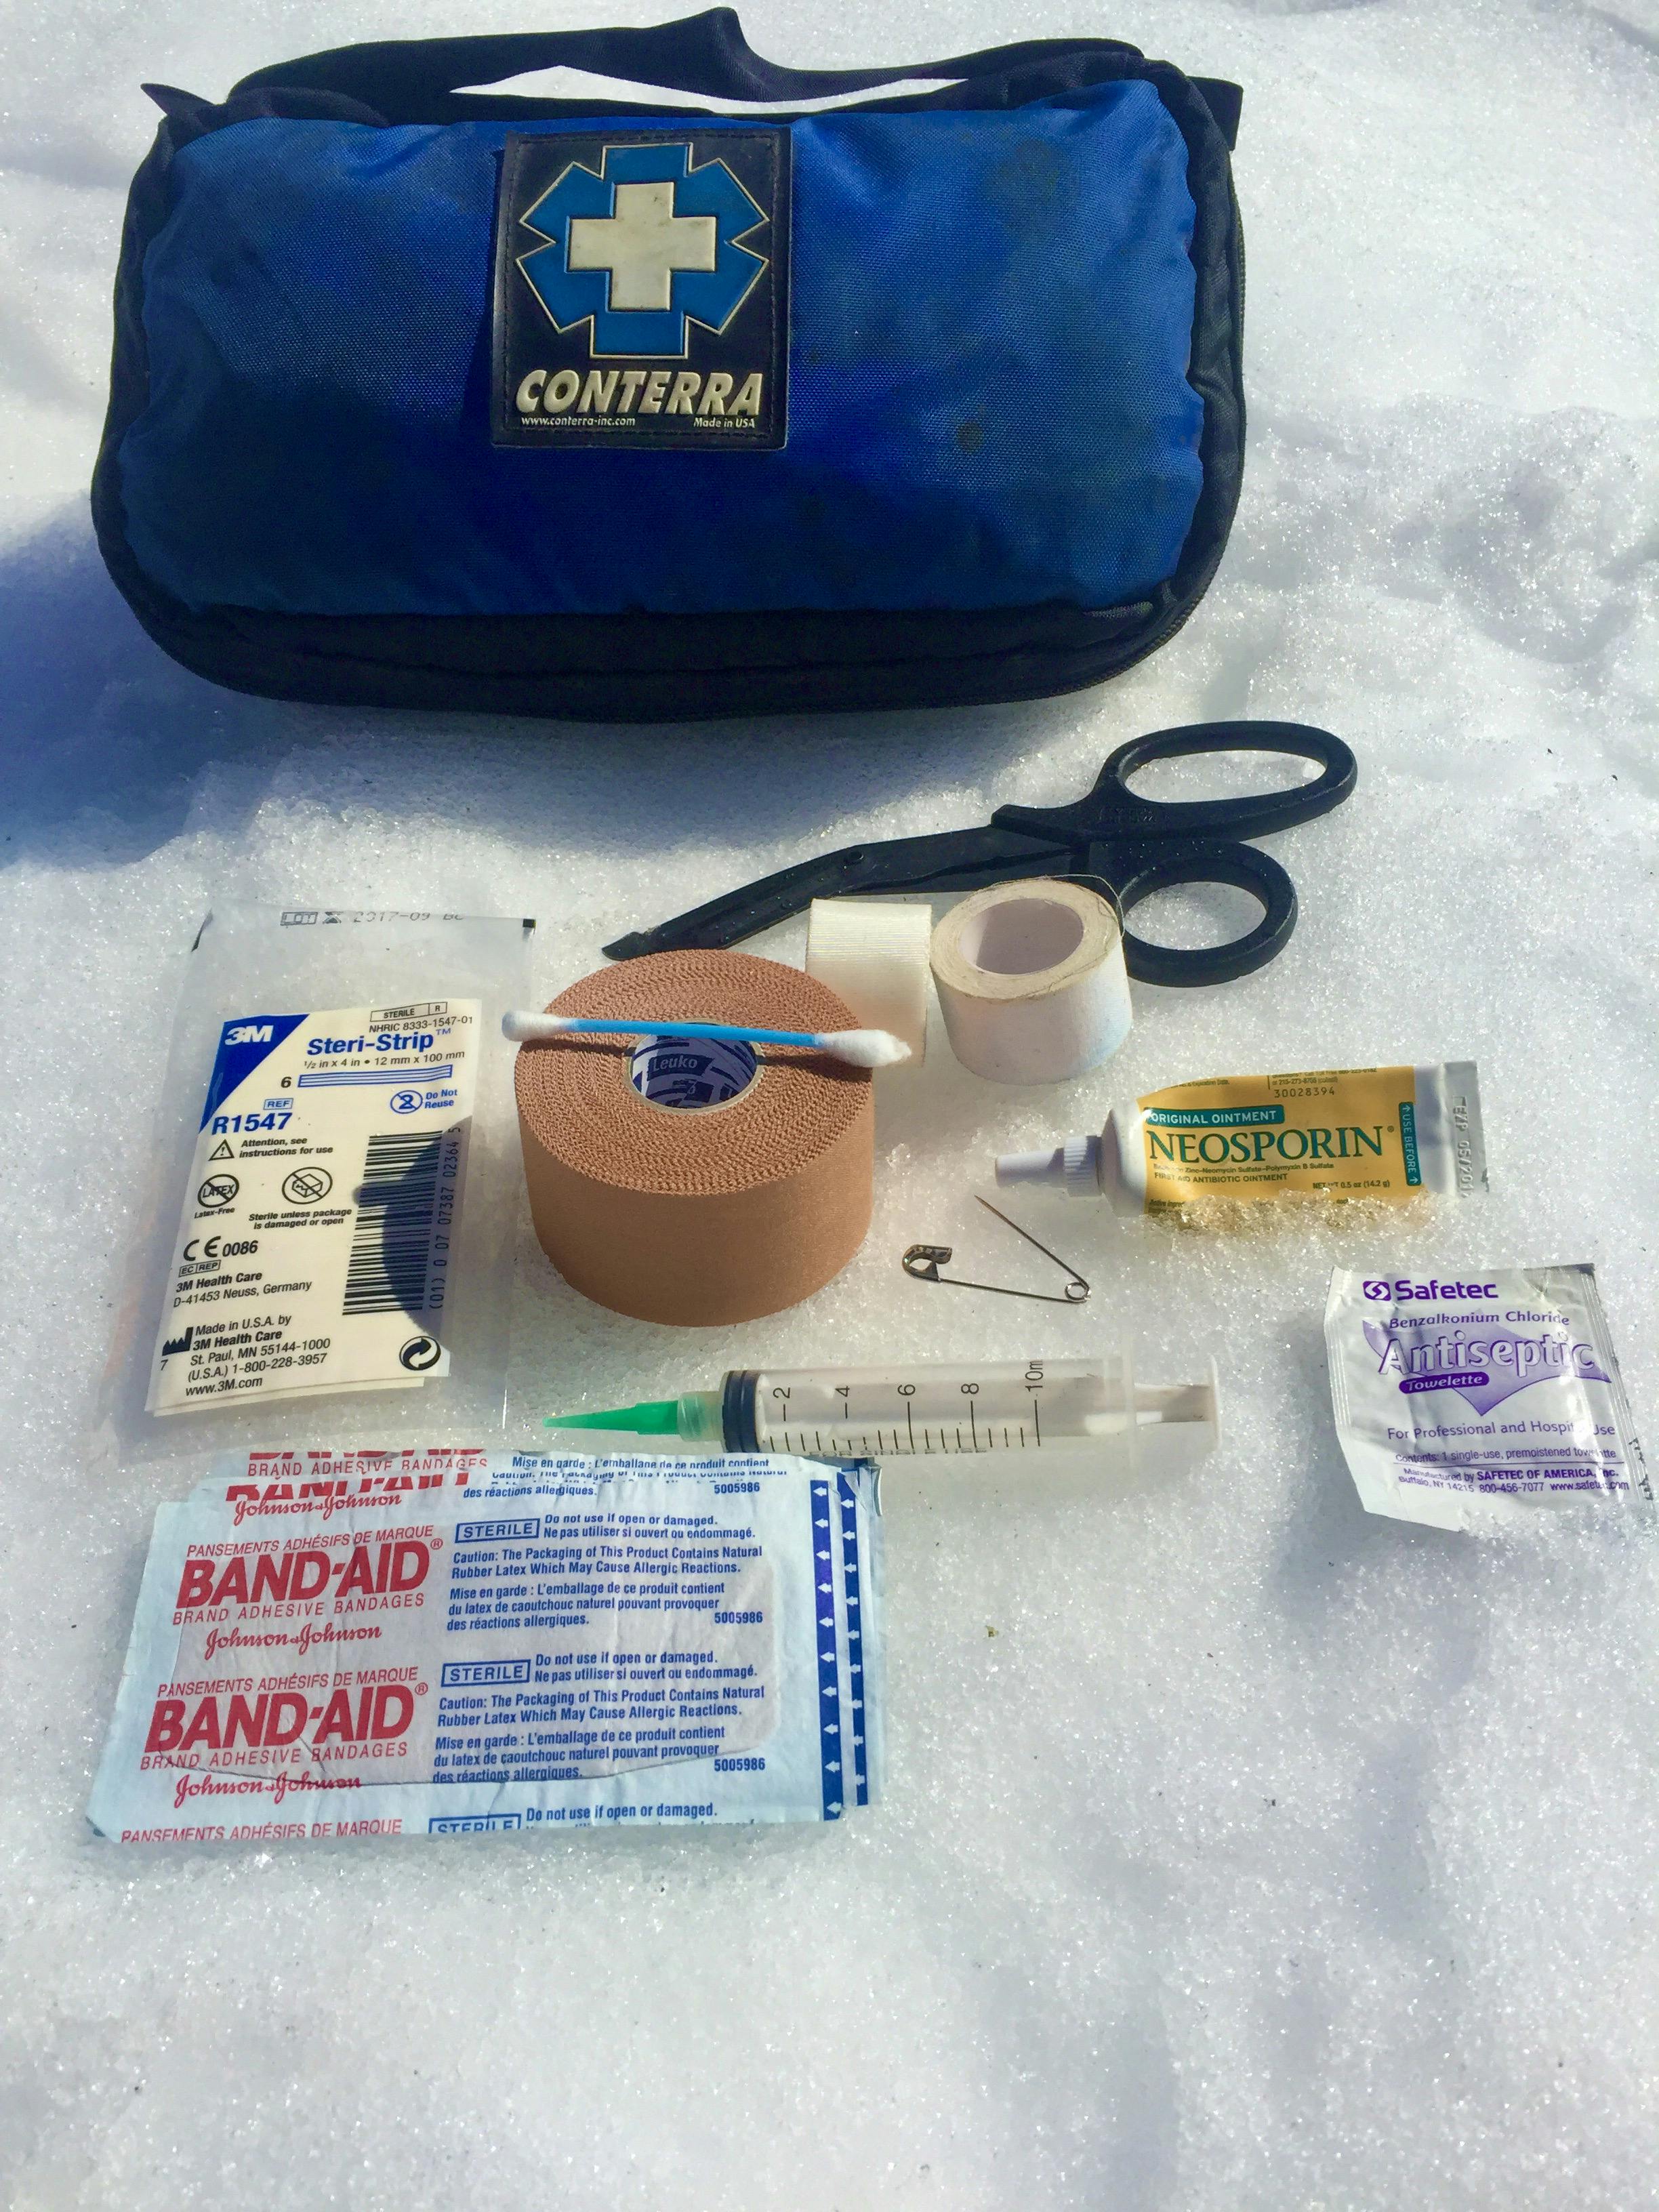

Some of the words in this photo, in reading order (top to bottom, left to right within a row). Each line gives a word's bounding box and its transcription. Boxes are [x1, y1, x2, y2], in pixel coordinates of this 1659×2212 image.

[516, 369, 763, 416] CONTERRA
[522, 416, 636, 426] www.conterra-inc.com
[694, 417, 721, 427] Made
[724, 418, 733, 428] in
[735, 418, 755, 428] USA
[384, 1008, 415, 1019] STERILE
[369, 1023, 400, 1033] NHRIC
[403, 1016, 472, 1031] 8333-1547-01
[224, 1025, 273, 1045] 3M
[307, 1032, 434, 1055] Steri-Strip
[319, 1060, 329, 1068] in
[375, 1057, 388, 1065] 12
[424, 1053, 443, 1063] 100
[445, 1051, 465, 1060] mm
[653, 1054, 698, 1071] Leuko
[281, 1077, 291, 1088] 6
[426, 1092, 438, 1100] Do
[441, 1089, 457, 1097] Not
[1274, 1086, 1334, 1098] 30028394
[425, 1100, 454, 1109] Reuse
[211, 1112, 293, 1135] R1547
[1151, 1113, 1208, 1124] ORIGINAL
[1212, 1111, 1276, 1124] OINTMENT
[1402, 1113, 1412, 1133] USE
[1453, 1106, 1469, 1132] EXP
[241, 1139, 288, 1147] Attention,
[1146, 1126, 1383, 1164] NEOSPORIN
[239, 1148, 297, 1158] instructions
[442, 1141, 459, 1178] 02364
[1404, 1136, 1417, 1174] BEFORE
[1243, 1173, 1288, 1182] OINTMENT
[1363, 1180, 1381, 1189] (14.2
[1382, 1179, 1390, 1188] g)
[437, 1186, 455, 1225] 07387
[249, 1212, 279, 1221] Sterile
[312, 1209, 352, 1218] package
[264, 1219, 307, 1229] damaged
[321, 1218, 344, 1226] open
[222, 1240, 258, 1257] 0086
[434, 1235, 450, 1250] 07
[181, 1266, 194, 1274] EC
[199, 1262, 218, 1271] REP
[176, 1280, 193, 1292] 3M
[196, 1275, 232, 1289] Health
[236, 1273, 262, 1283] Care
[1395, 1279, 1498, 1301] Safetec
[173, 1290, 220, 1308] D-41453
[223, 1288, 259, 1299] Neuss,
[263, 1282, 312, 1294] Germany
[429, 1277, 446, 1309] (01)
[195, 1323, 226, 1336] Made
[228, 1321, 239, 1331] in
[242, 1316, 274, 1329] U.S.A.
[278, 1315, 291, 1326] by
[1390, 1312, 1500, 1329] Benzalkonium
[1505, 1311, 1570, 1326] Chloride
[193, 1338, 211, 1351] 3M
[214, 1333, 252, 1347] Health
[255, 1331, 282, 1342] Care
[190, 1354, 204, 1366] St.
[208, 1349, 234, 1363] Paul,
[238, 1347, 257, 1358] MN
[260, 1338, 330, 1356] 55144-1000
[1378, 1330, 1595, 1378] Antiseptic
[161, 1359, 169, 1371] 7
[188, 1365, 228, 1382] (U.S.A.)
[233, 1353, 327, 1374] 1-800-228-3957
[186, 1377, 262, 1396] www.3M.com
[834, 1385, 850, 1397] 4
[897, 1383, 916, 1396] 6
[961, 1382, 979, 1395] 8
[1406, 1374, 1483, 1391] Towelette
[773, 1387, 791, 1399] 2
[1387, 1427, 1409, 1440] For
[1414, 1421, 1496, 1439] Professional
[1500, 1420, 1525, 1433] and
[1395, 1452, 1439, 1462] Contents:
[1441, 1451, 1448, 1461] 1
[1451, 1449, 1504, 1462] single-use,
[1505, 1446, 1571, 1460] premoistened
[1464, 1471, 1475, 1483] by
[1477, 1469, 1523, 1481] SAFETEC
[1526, 1469, 1541, 1479] OF
[1544, 1468, 1597, 1479] AMERICA,
[1398, 1475, 1432, 1488] Buffalo,
[1433, 1480, 1444, 1488] NY
[1447, 1482, 1475, 1492] 14215
[1479, 1481, 1544, 1494] 800-456-7077
[545, 1515, 559, 1523] Do
[563, 1515, 581, 1523] not
[607, 1513, 615, 1522] if
[619, 1515, 645, 1525] open
[663, 1515, 718, 1528] damaged.
[464, 1523, 533, 1538] STERILE
[544, 1527, 558, 1538] Ne
[560, 1528, 579, 1540] pas
[582, 1525, 620, 1537] utiliser
[622, 1527, 631, 1537] si
[635, 1528, 668, 1538] ouvert
[671, 1530, 683, 1538] ou
[687, 1527, 755, 1540] endommagé.
[186, 1540, 279, 1558] PANSEMENTS
[283, 1532, 350, 1551] ADHÉSIFS
[354, 1530, 371, 1545] DE
[375, 1525, 434, 1542] MARQUE
[453, 1551, 498, 1564] Caution:
[502, 1549, 522, 1560] The
[526, 1547, 582, 1561] Packaging
[586, 1546, 596, 1557] of
[600, 1546, 623, 1557] This
[627, 1547, 668, 1559] Product
[672, 1547, 719, 1559] Contains
[722, 1546, 762, 1557] Natural
[176, 1540, 430, 1610] BAND-AID
[172, 1607, 230, 1626] BRAND
[237, 1601, 325, 1620] ADHESIVE
[333, 1592, 426, 1614] BANDAGES
[714, 1611, 763, 1624] 5005986
[143, 1683, 415, 1754] BAND-AID
